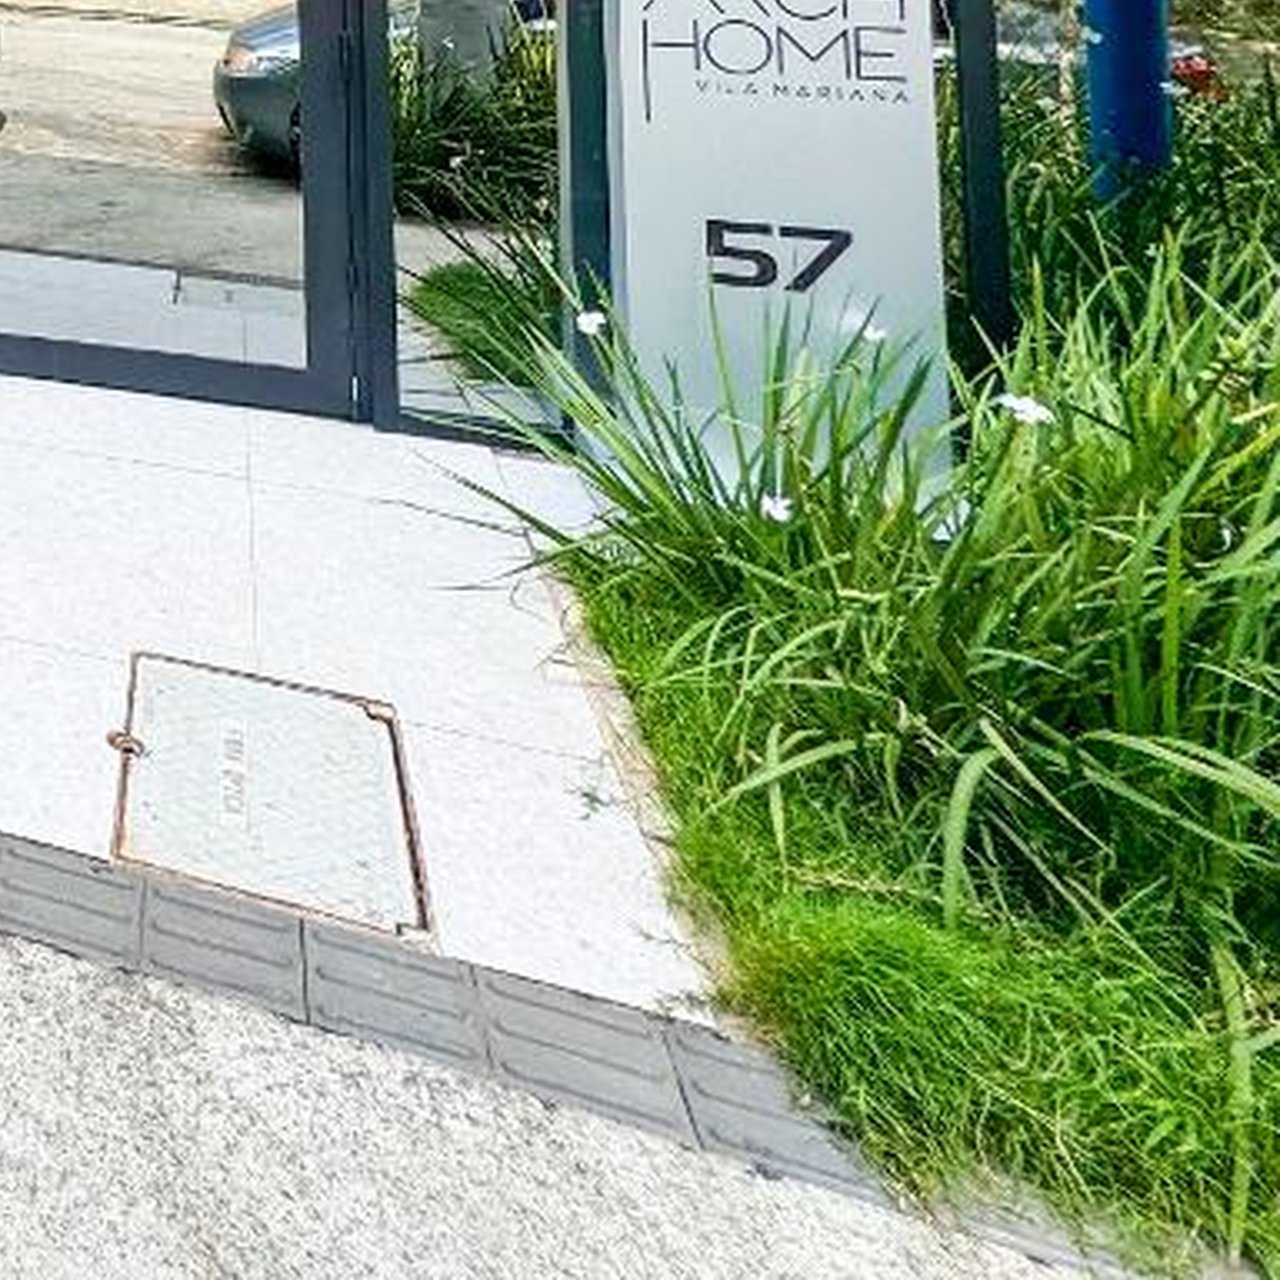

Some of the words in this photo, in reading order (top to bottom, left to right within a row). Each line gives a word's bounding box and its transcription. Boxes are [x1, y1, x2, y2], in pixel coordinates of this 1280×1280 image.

[641, 19, 907, 123] HOME
[695, 79, 759, 97] VILA
[771, 82, 910, 104] MARIANA
[705, 219, 854, 293] 57
